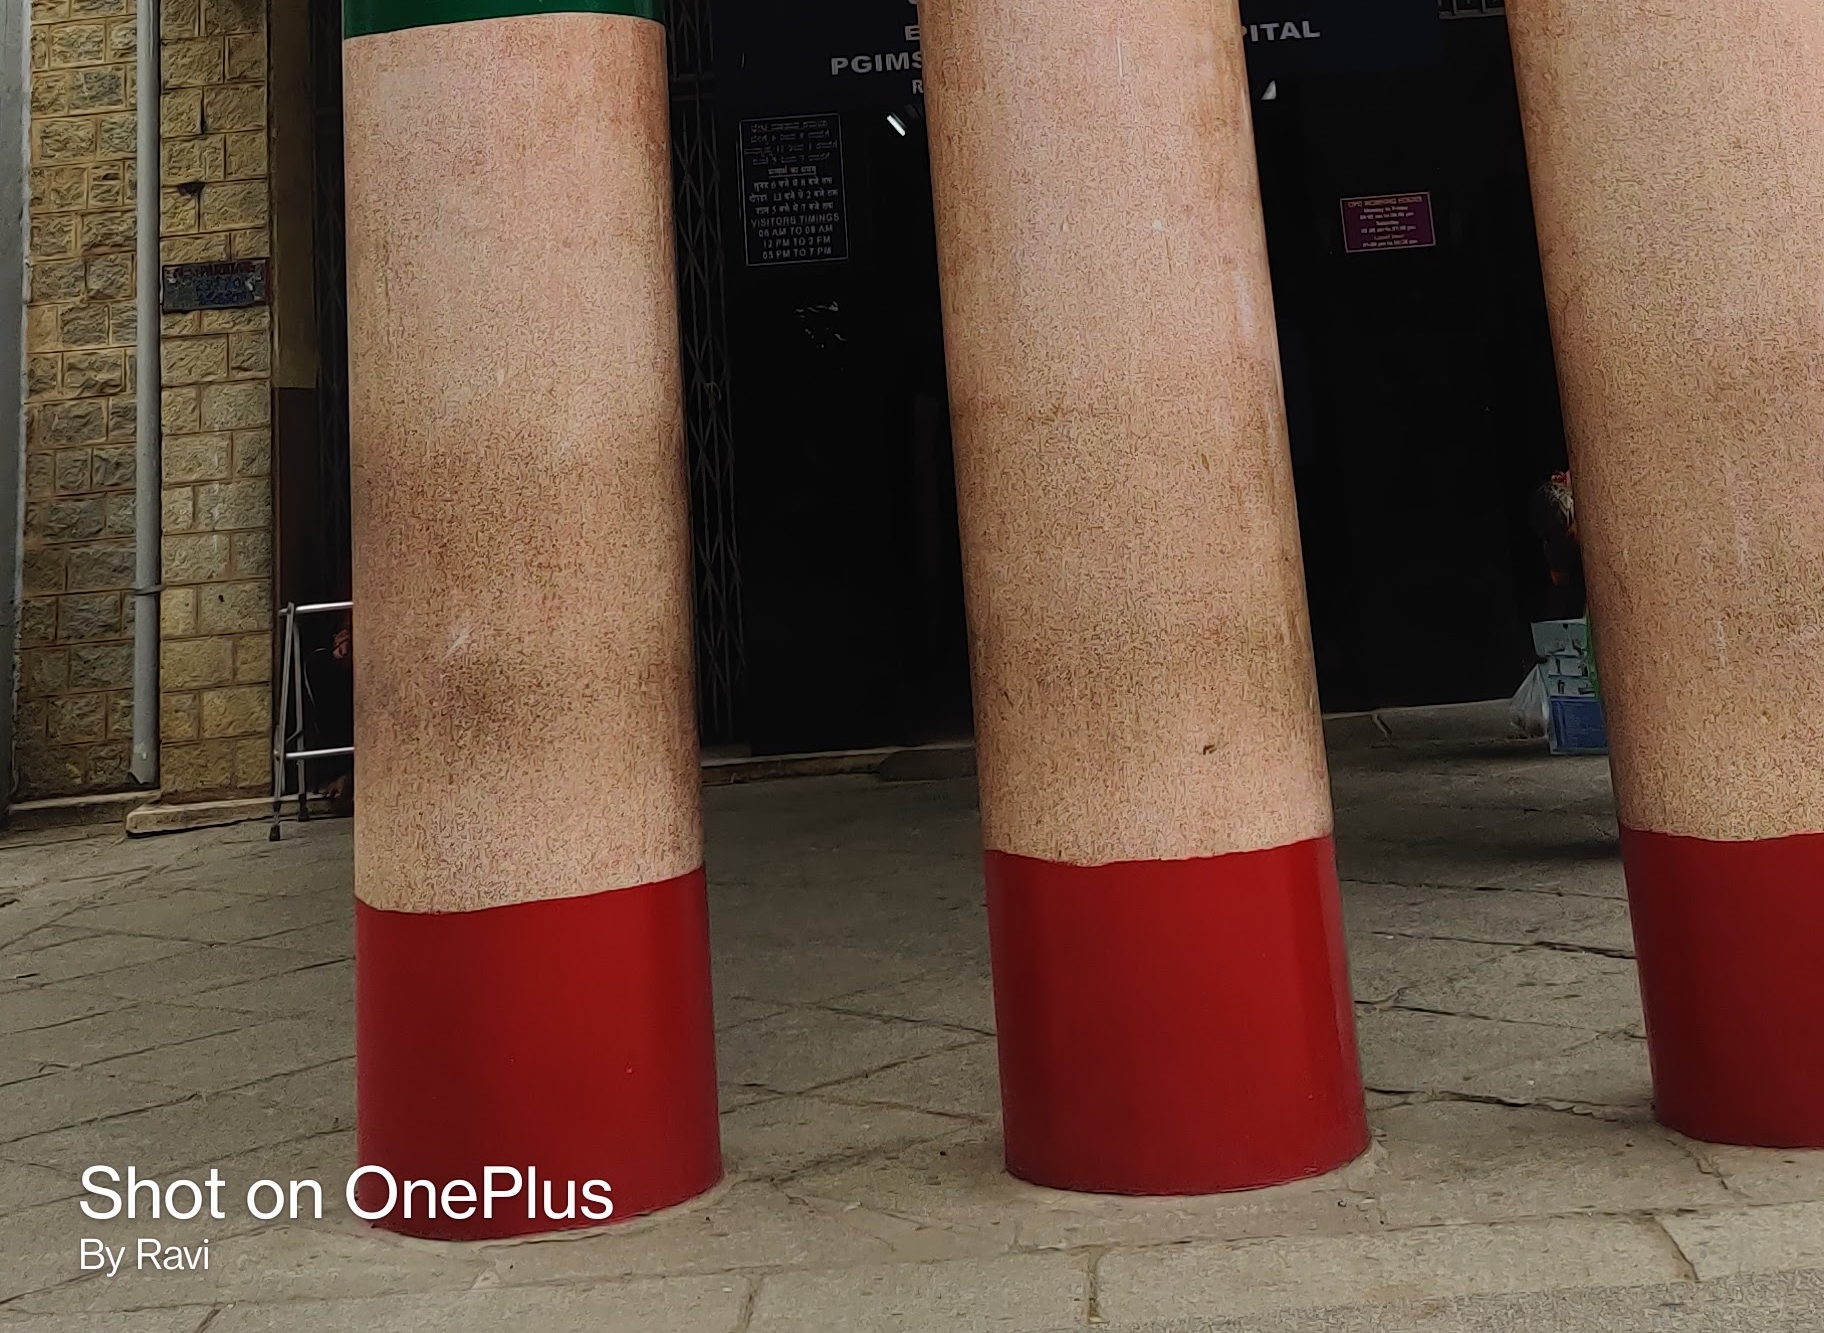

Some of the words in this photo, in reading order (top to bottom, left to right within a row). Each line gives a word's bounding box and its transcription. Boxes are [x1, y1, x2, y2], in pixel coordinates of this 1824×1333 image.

[1241, 20, 1321, 42] ITAL
[800, 213, 840, 225] TIMINGS
[772, 228, 786, 237] AM
[790, 226, 802, 236] TO
[818, 224, 833, 233] AM
[793, 237, 805, 246] TO
[776, 250, 790, 259] PM
[793, 248, 806, 257] TO
[817, 246, 832, 256] PM
